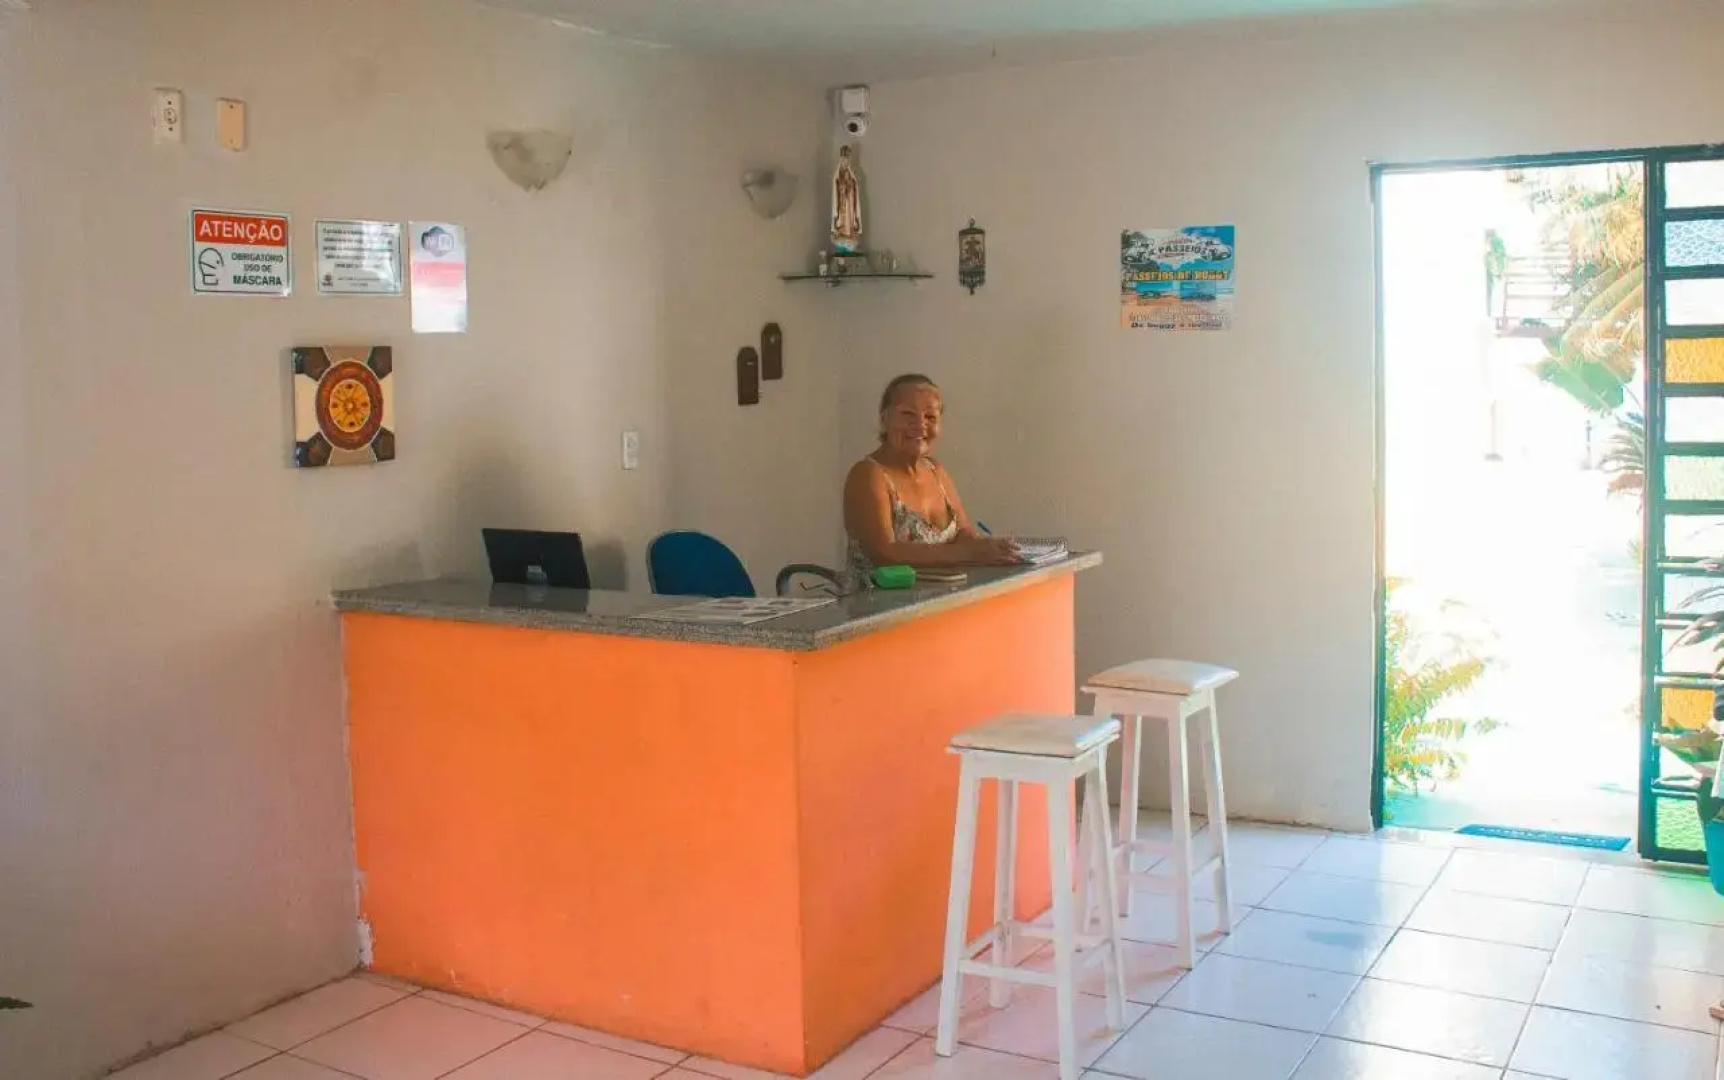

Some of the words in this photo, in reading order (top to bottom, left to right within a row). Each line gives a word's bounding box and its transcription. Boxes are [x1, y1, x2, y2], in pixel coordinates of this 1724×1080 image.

[199, 219, 283, 243] ATENÇÃO
[231, 252, 284, 263] OBRIGATÓRIO
[243, 263, 261, 272] USO
[261, 264, 272, 273] DE
[232, 272, 283, 286] MÁSCARA
